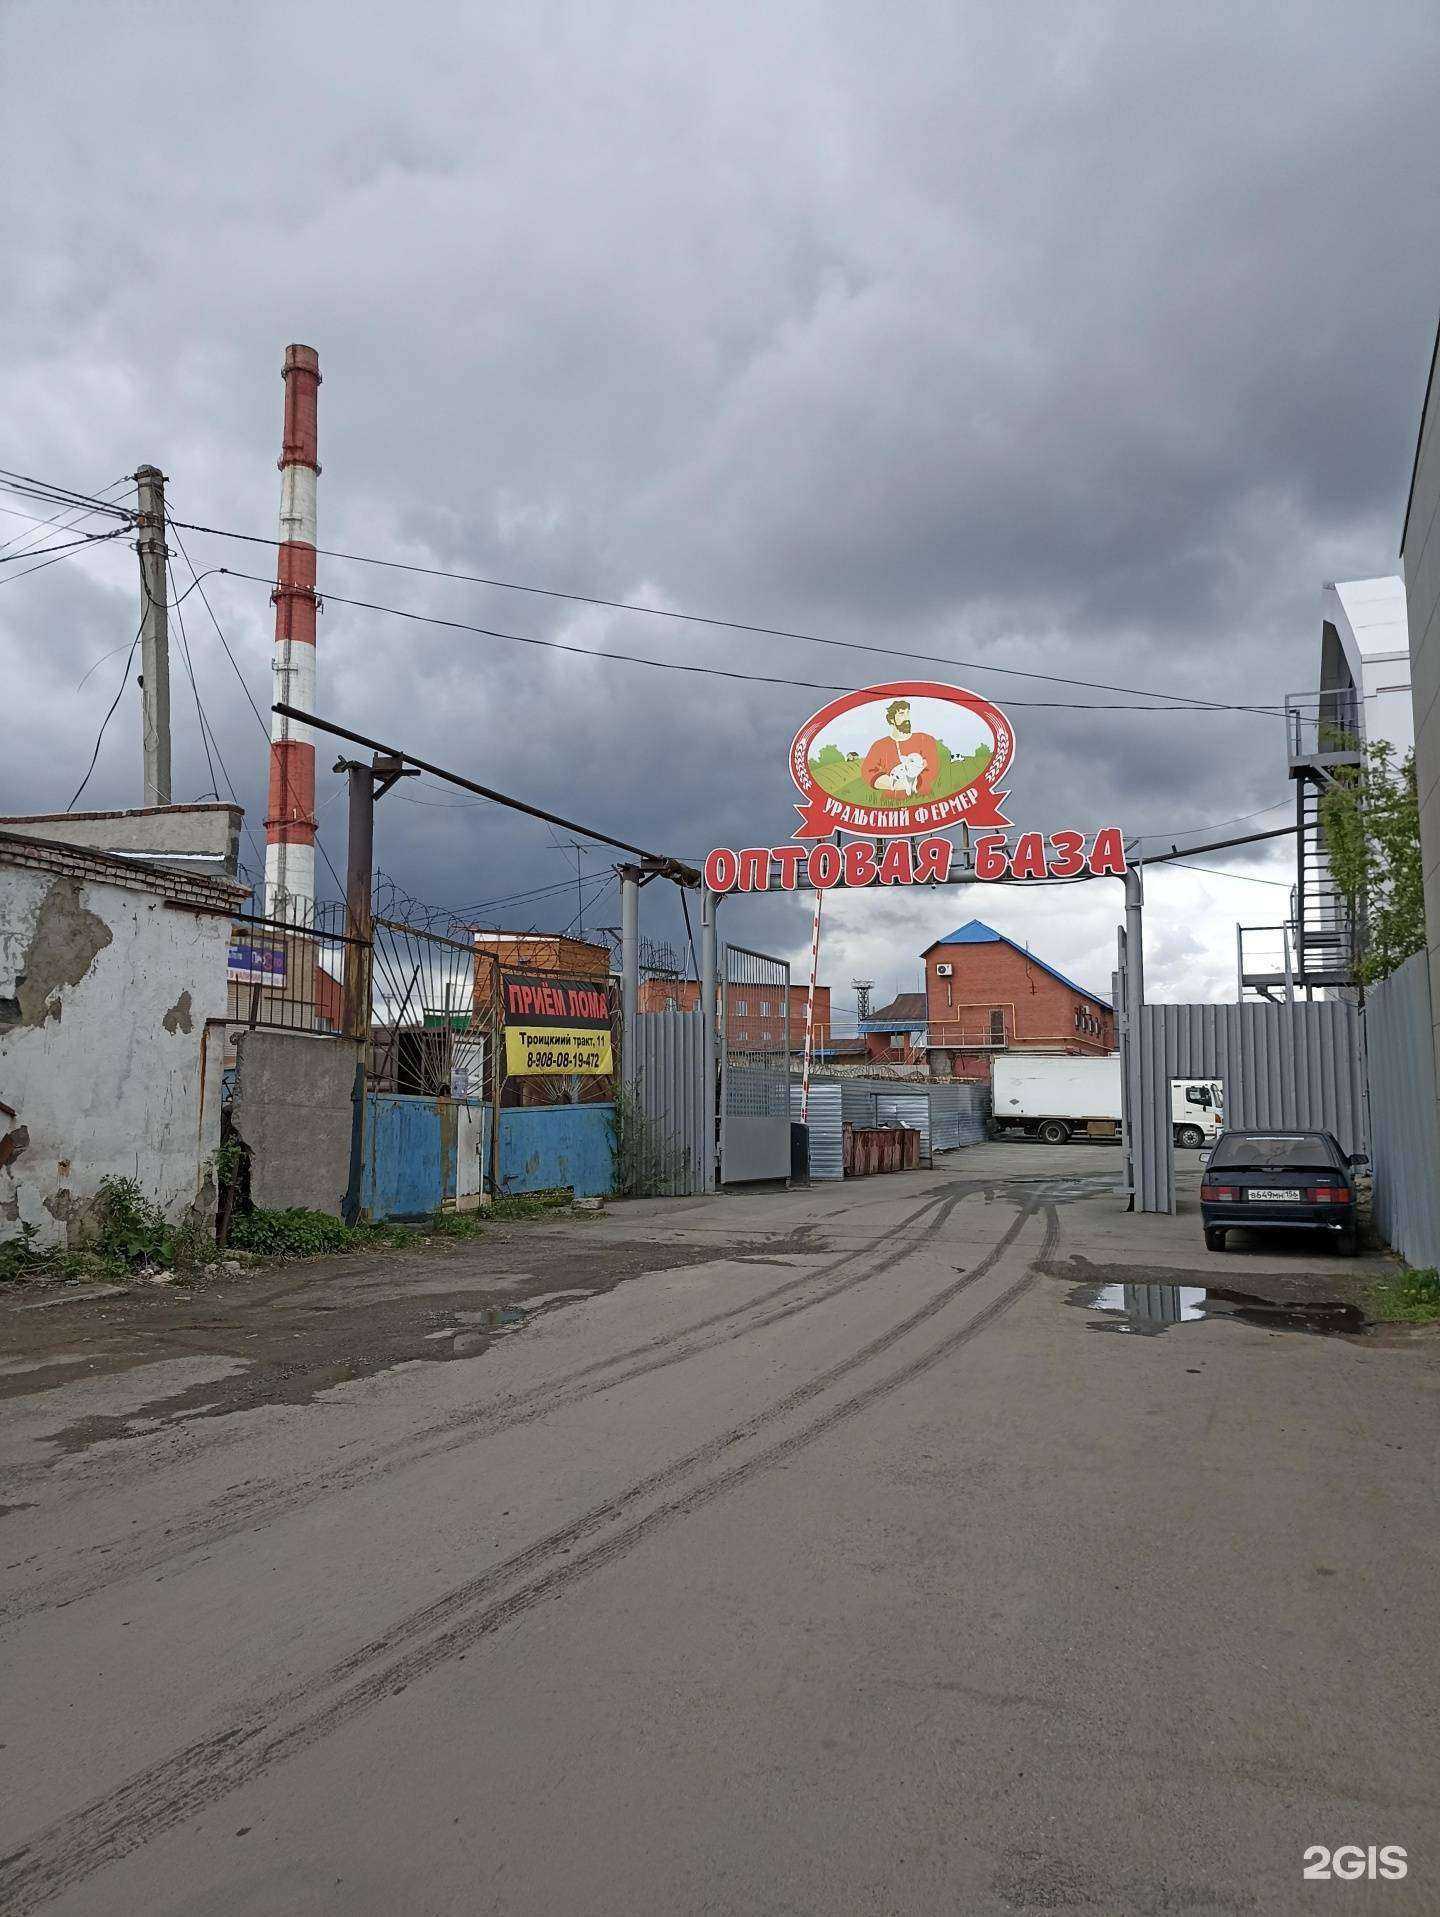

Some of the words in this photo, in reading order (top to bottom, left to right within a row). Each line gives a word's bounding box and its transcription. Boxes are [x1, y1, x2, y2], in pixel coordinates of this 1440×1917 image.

[822, 797, 910, 828] УРАЛЬСКИЙ
[914, 788, 979, 824] ФЕРМЕР
[704, 838, 953, 893] ОПТОВАЯ
[973, 827, 1128, 880] БАЗА
[508, 982, 567, 1016] ПРИЁМ
[568, 990, 609, 1019] ЛОМА
[596, 1036, 605, 1047] 11
[527, 1052, 600, 1069] 8-908-08-19-472
